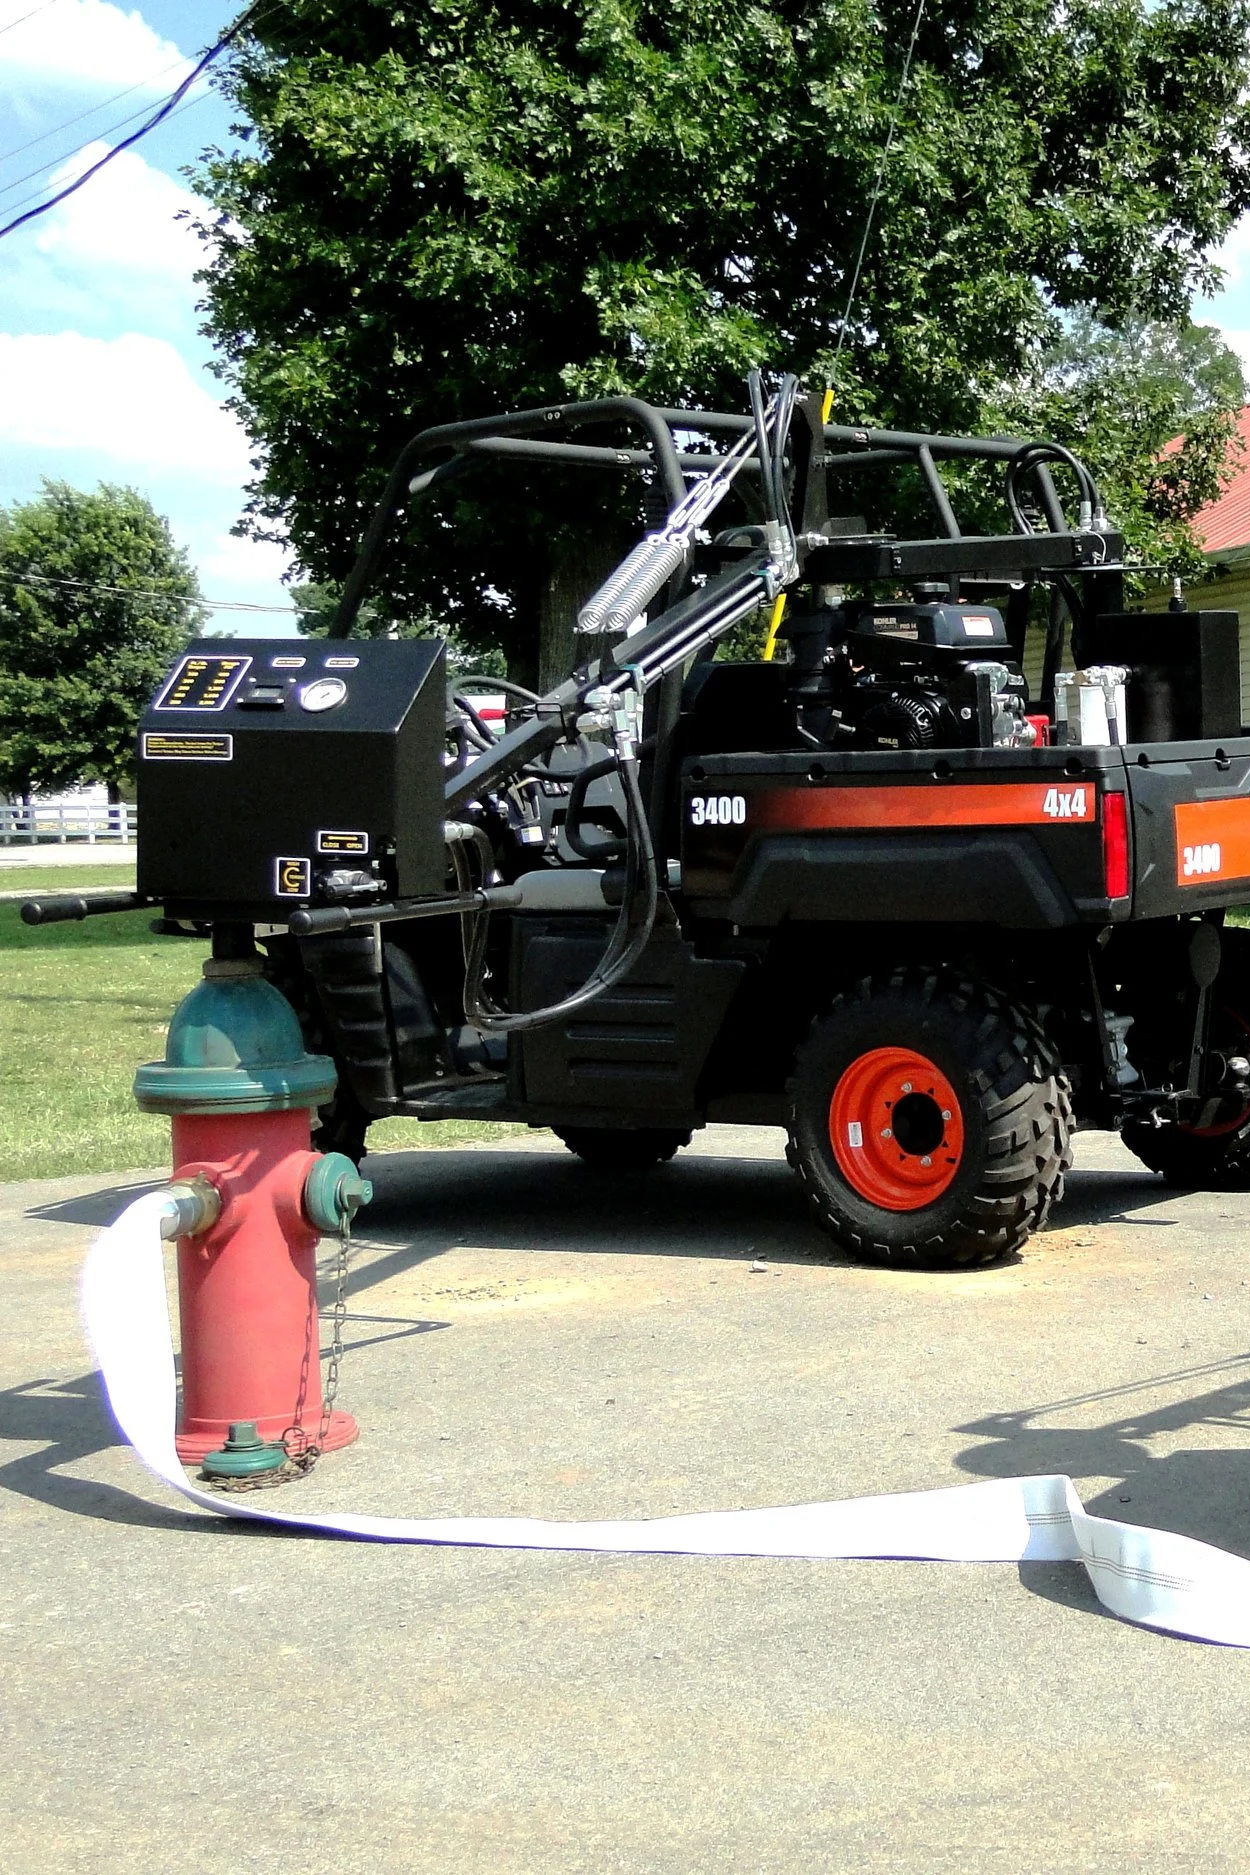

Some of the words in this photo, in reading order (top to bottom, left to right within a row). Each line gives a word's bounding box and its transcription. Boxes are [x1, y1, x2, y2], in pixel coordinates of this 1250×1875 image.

[691, 796, 746, 825] 3400
[1043, 788, 1087, 817] 4x4
[1183, 842, 1221, 876] 3400
